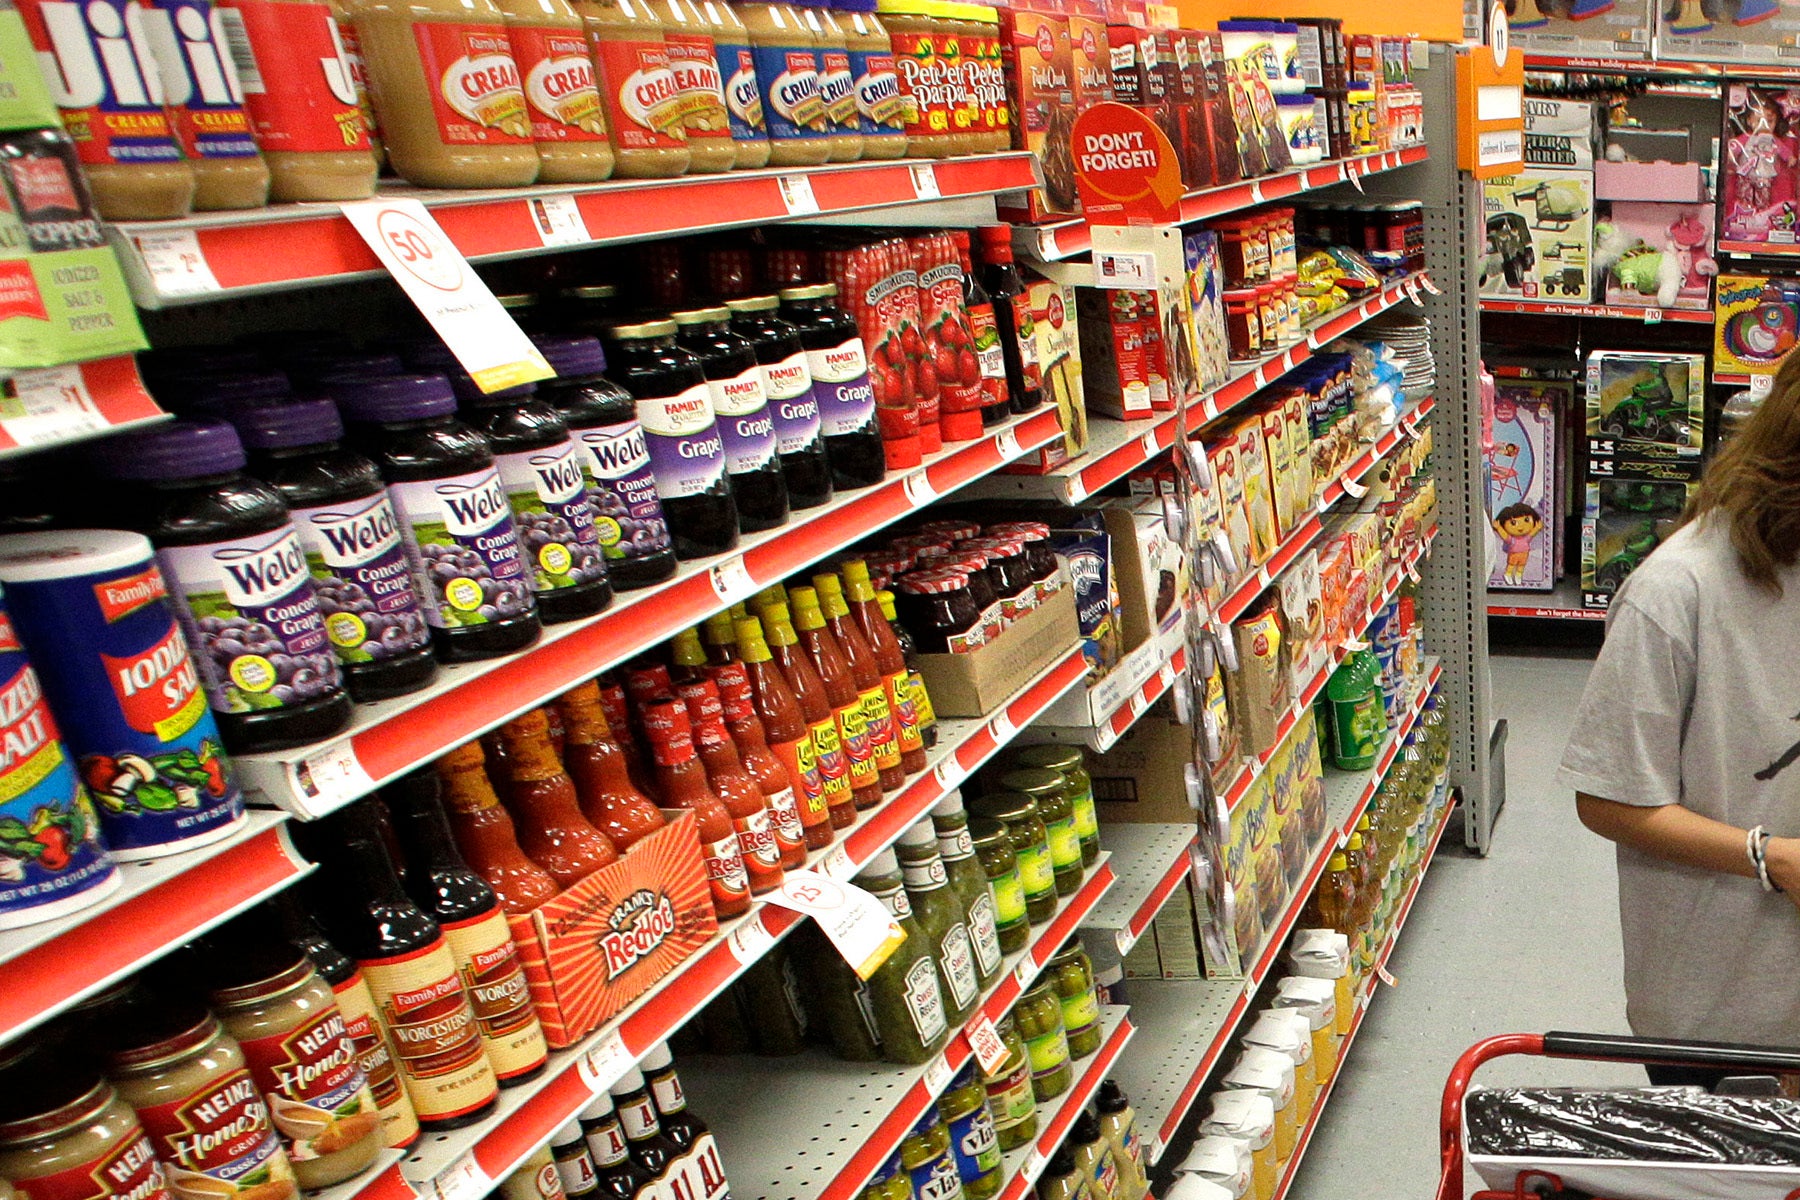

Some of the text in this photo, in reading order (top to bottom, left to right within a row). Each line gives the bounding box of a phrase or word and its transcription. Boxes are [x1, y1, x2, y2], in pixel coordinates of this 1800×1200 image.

[1568, 57, 1599, 67] celebrate
[1600, 58, 1626, 69] holiday
[1085, 131, 1143, 152] DON'T
[1081, 146, 1156, 170] FORGET!
[388, 221, 431, 263] 50
[1544, 305, 1560, 313] don't
[1562, 307, 1582, 316] forget
[1607, 309, 1623, 317] bags
[68, 312, 114, 331] PEPPER
[836, 384, 870, 401] Grape
[781, 404, 816, 420] Grape
[737, 419, 773, 437] Grape
[678, 441, 720, 460] Grape
[628, 486, 657, 502] Grape
[489, 544, 519, 563] Grape
[373, 576, 410, 595] Grape
[1553, 610, 1572, 618] forget
[1583, 611, 1607, 619] batterie
[608, 890, 655, 929] FRANK'S
[298, 1014, 347, 1057] HEINZ
[193, 1078, 254, 1125] HEINZ
